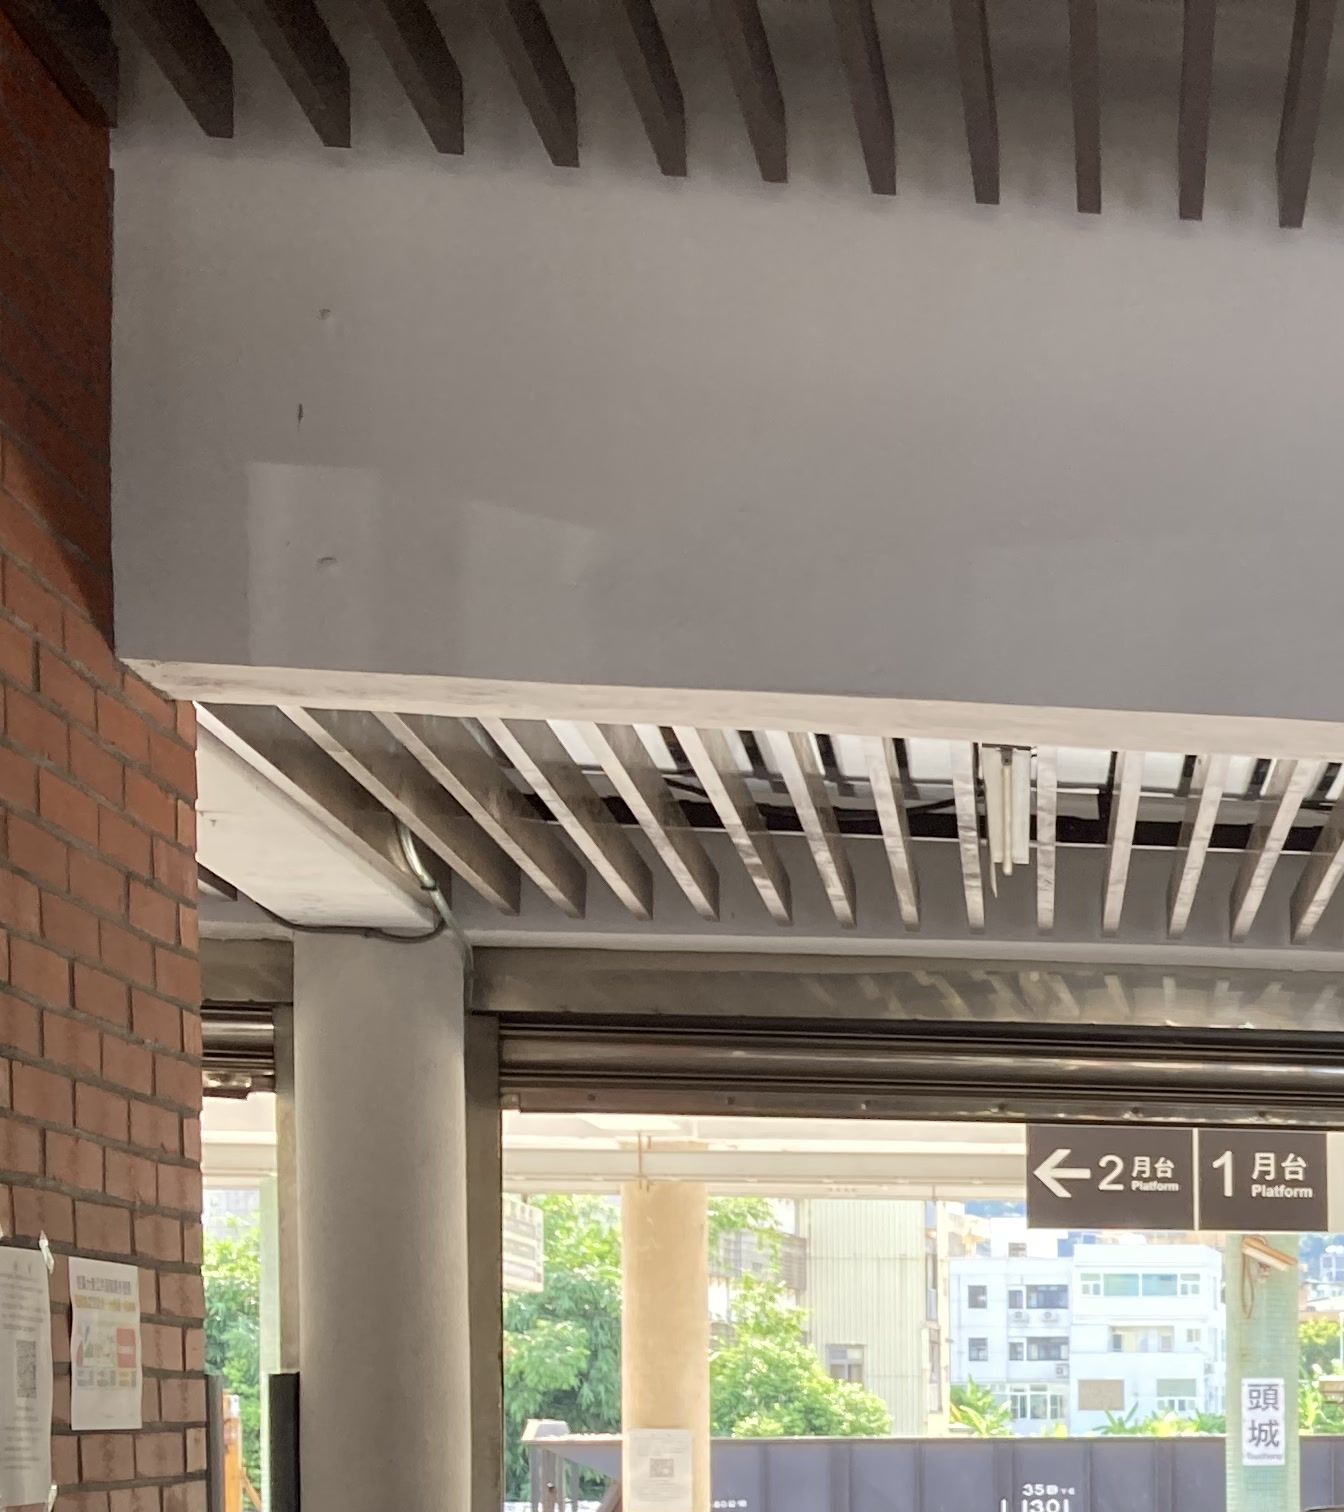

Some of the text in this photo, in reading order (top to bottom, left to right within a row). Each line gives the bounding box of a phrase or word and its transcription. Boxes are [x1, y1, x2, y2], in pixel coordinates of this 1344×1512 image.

[1098, 1154, 1124, 1190] 2
[1132, 1156, 1174, 1178] 月台
[1212, 1151, 1232, 1197] 1
[1251, 1152, 1307, 1181] 月台
[1131, 1180, 1179, 1192] Platform
[1251, 1185, 1313, 1199] Platform
[1247, 1384, 1279, 1447] 頭城
